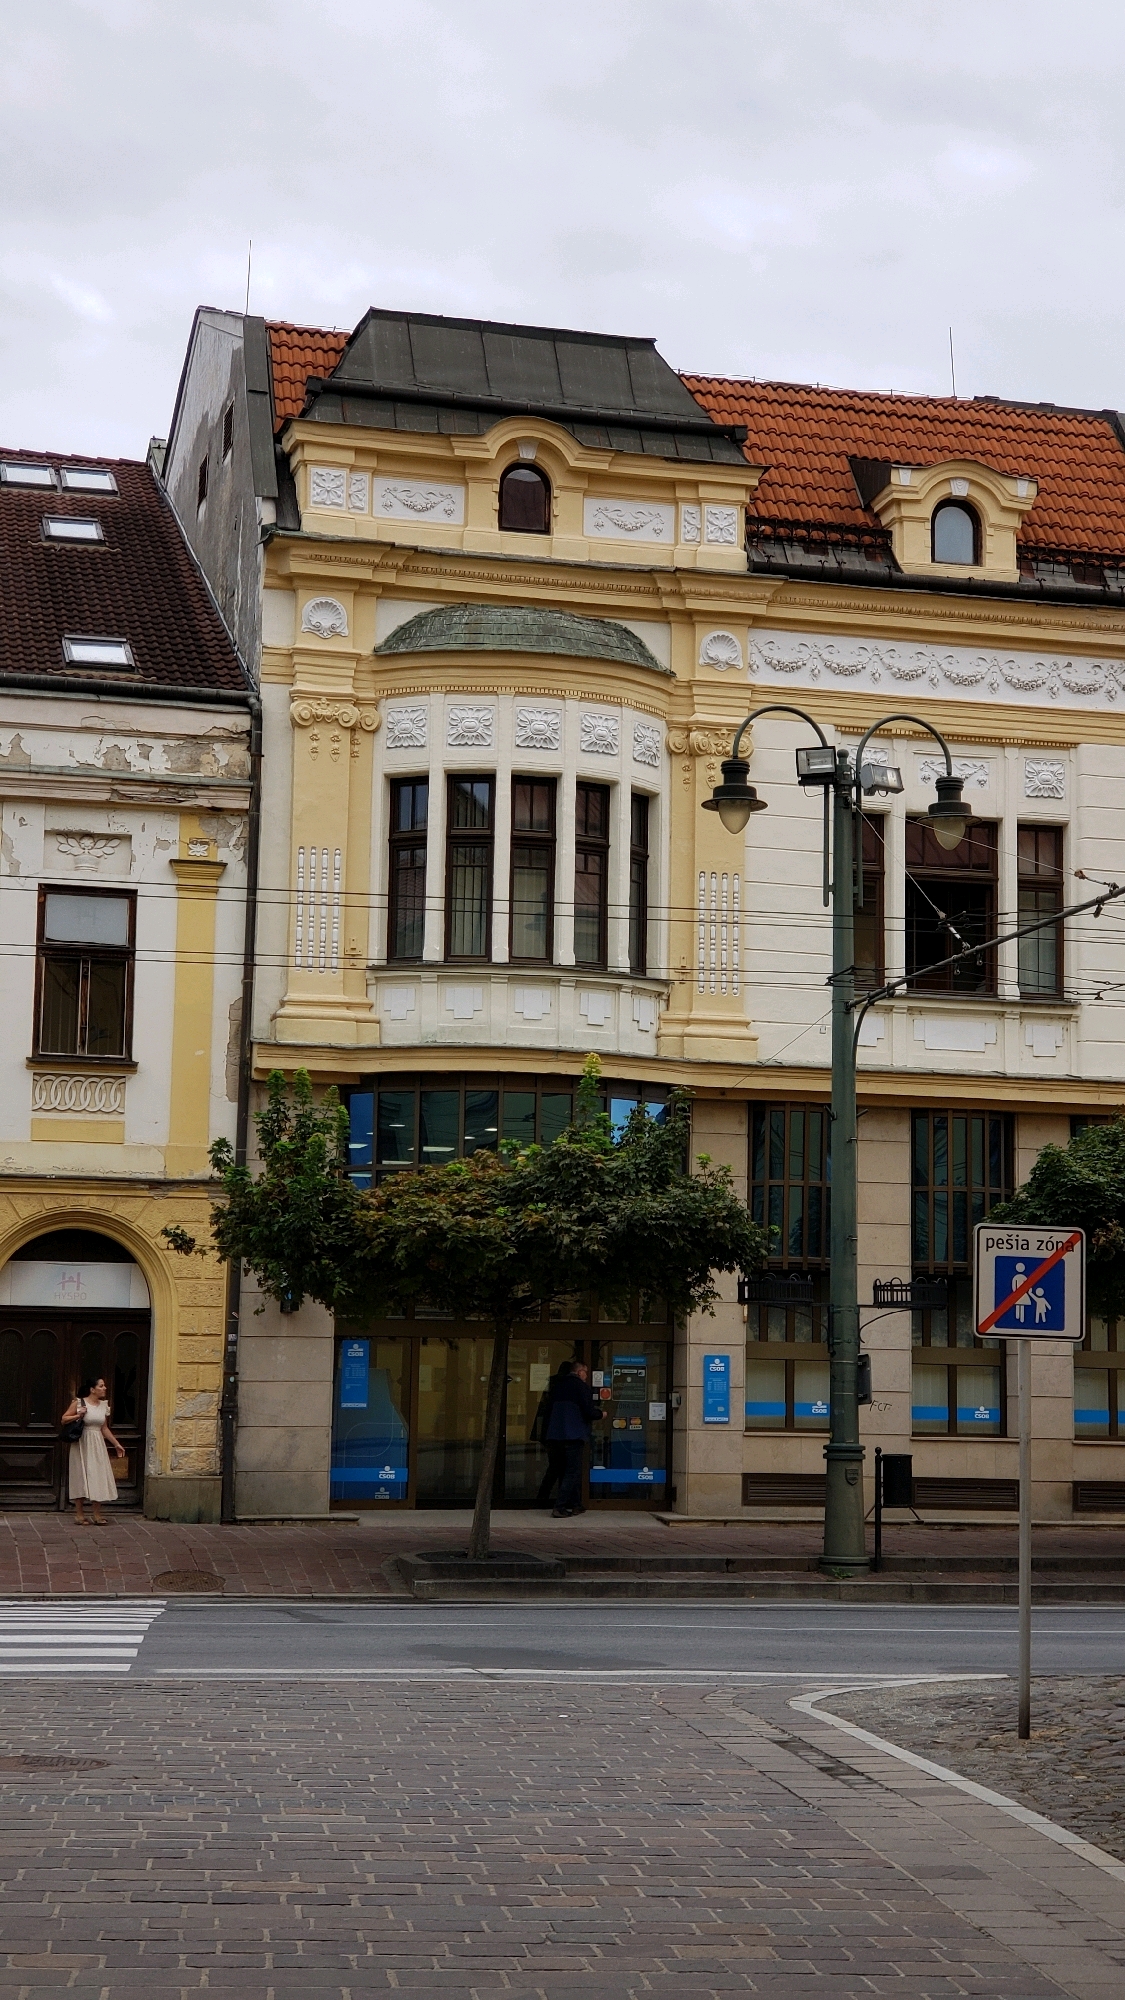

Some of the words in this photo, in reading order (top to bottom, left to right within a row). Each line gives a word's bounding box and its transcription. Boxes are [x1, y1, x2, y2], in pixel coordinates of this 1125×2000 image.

[985, 1233, 1030, 1252] pešia
[1036, 1236, 1075, 1252] zóna
[54, 1292, 87, 1300] HYSPO
